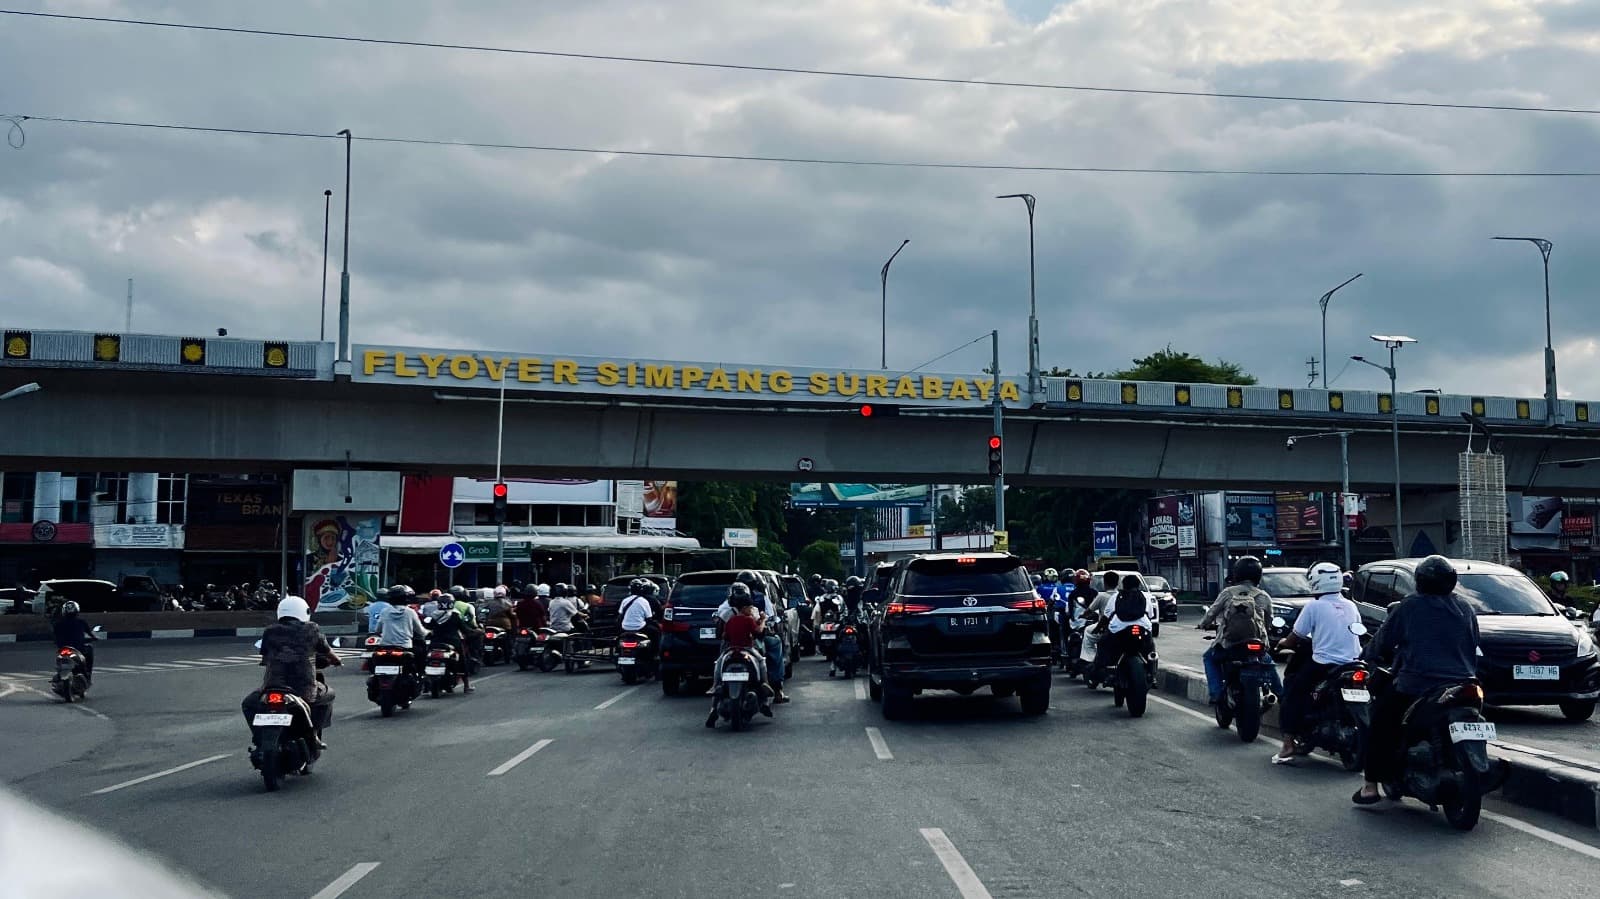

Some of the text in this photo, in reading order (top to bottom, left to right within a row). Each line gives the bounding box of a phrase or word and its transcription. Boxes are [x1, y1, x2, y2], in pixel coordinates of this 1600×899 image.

[362, 351, 1021, 403] FLYOVER SIMPANG SURABAYA
[216, 492, 262, 503] TEXAS
[468, 545, 490, 555] Grab
[1515, 665, 1525, 675] BL
